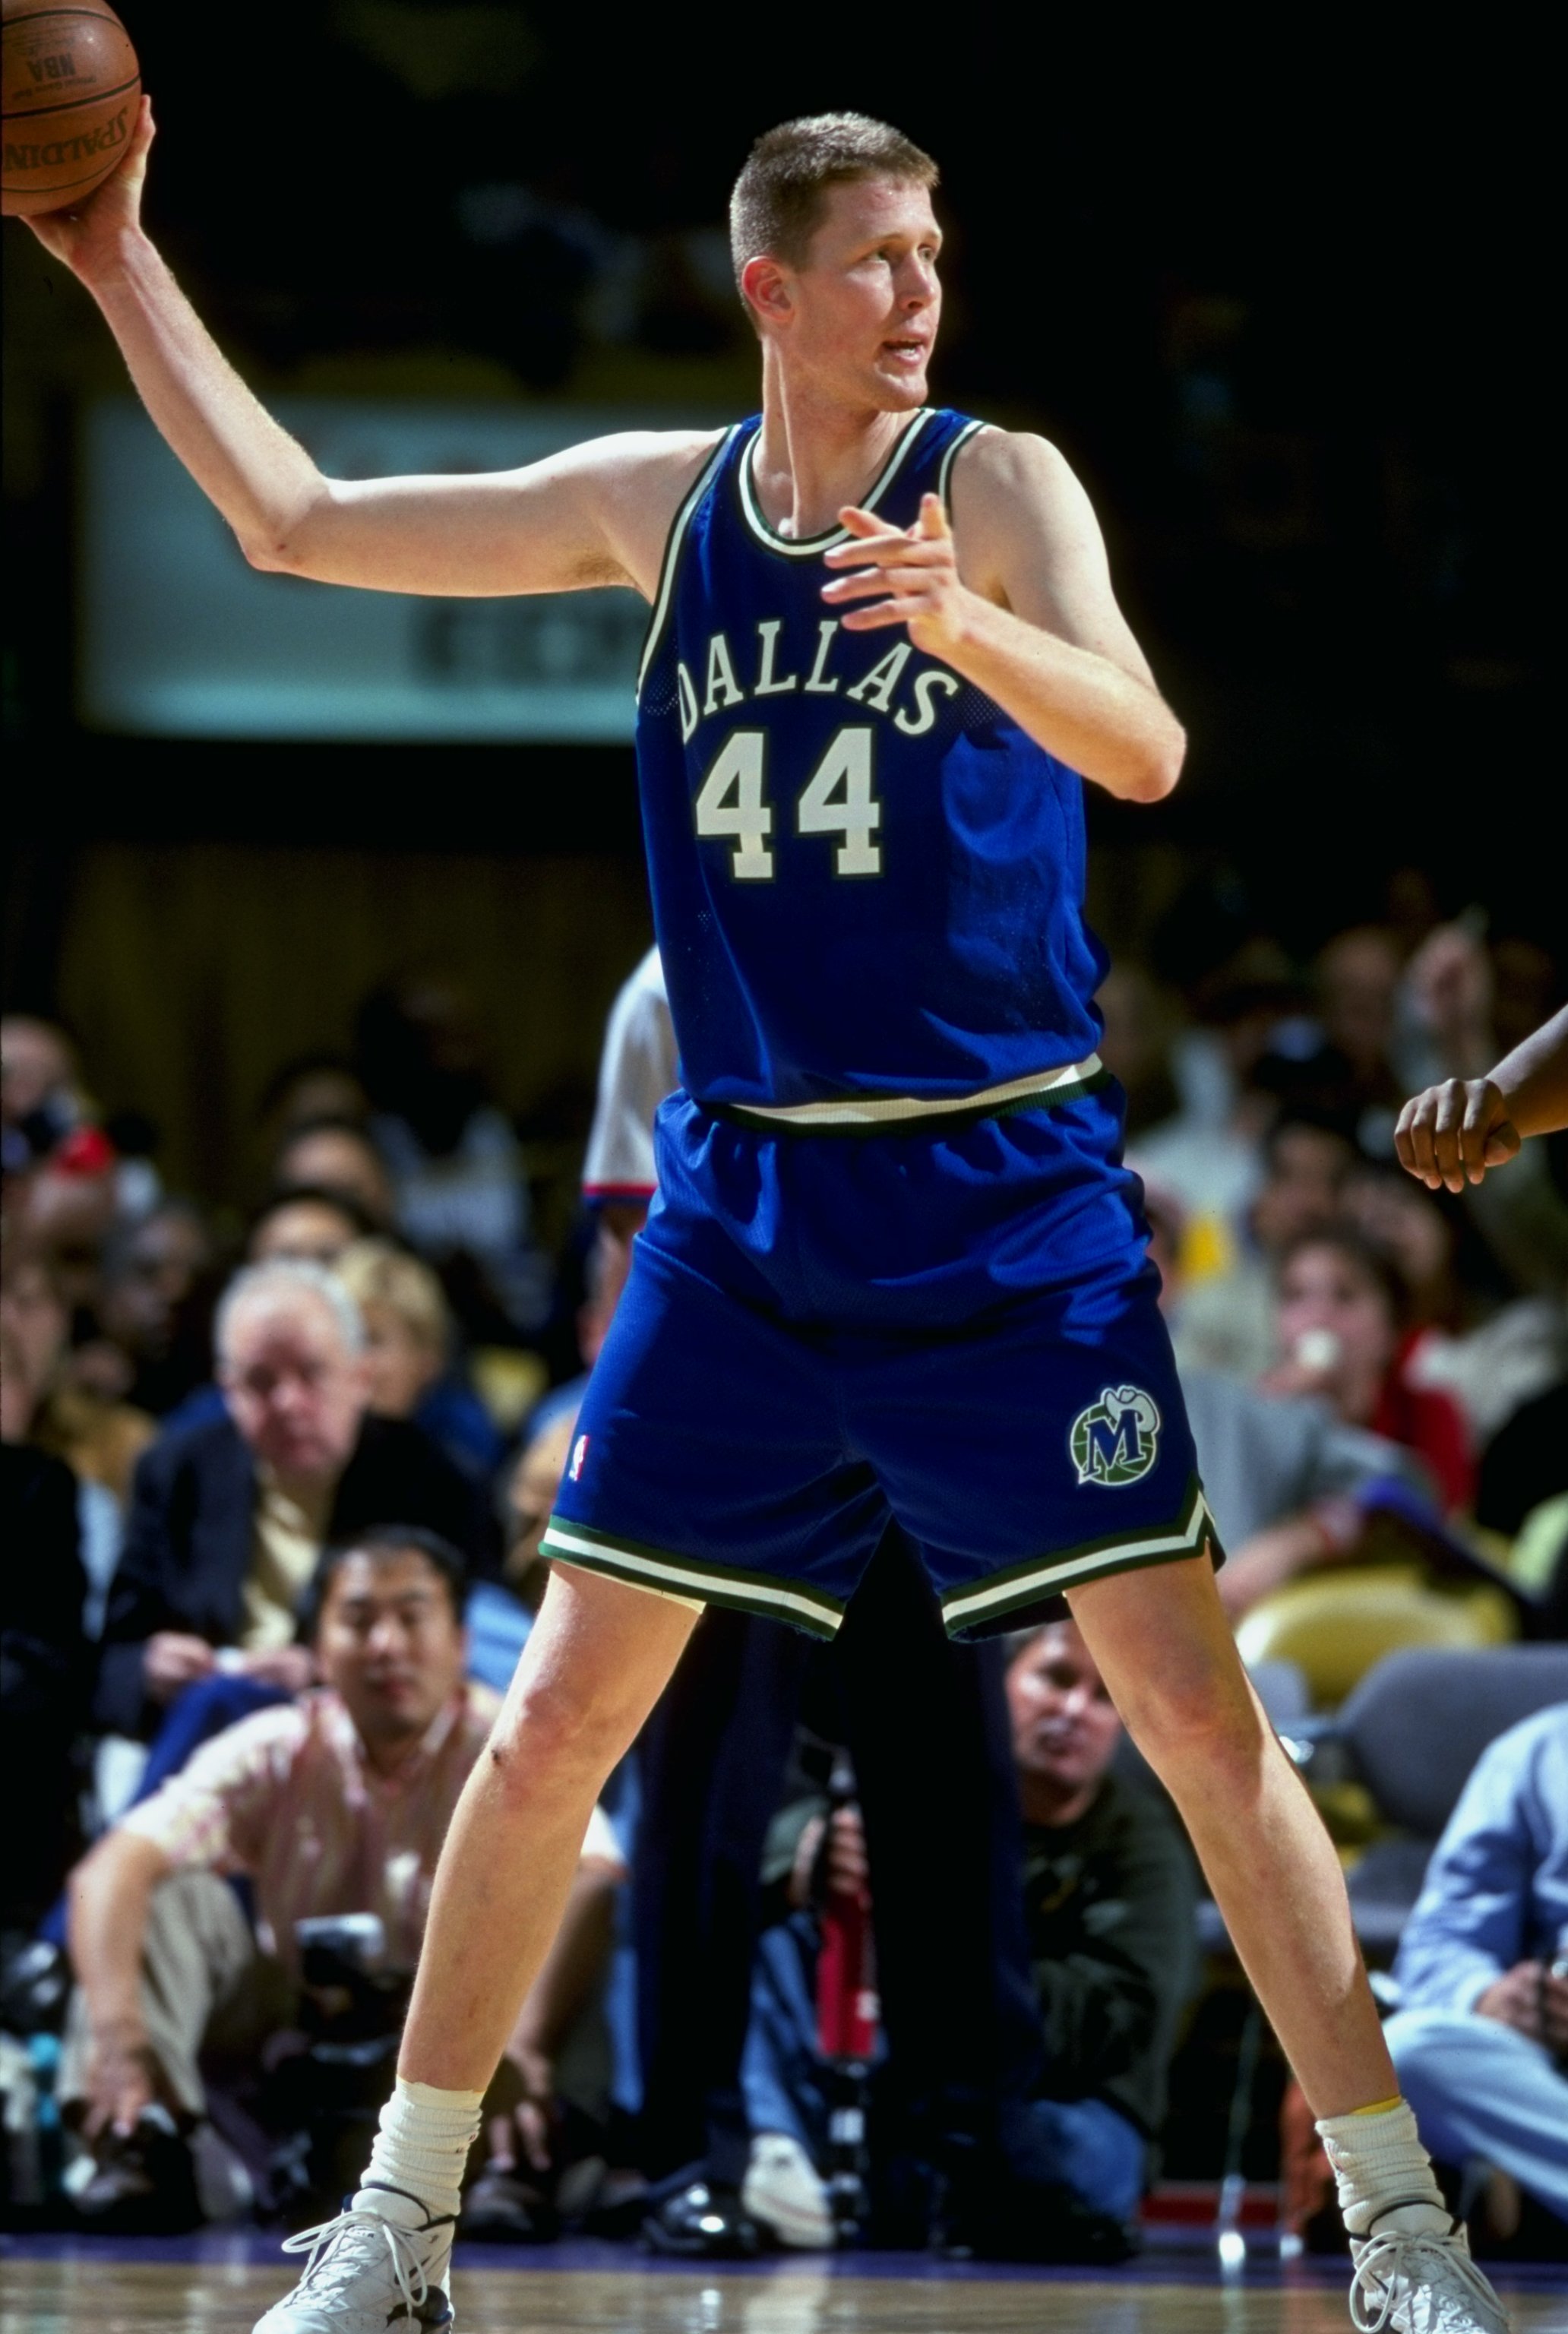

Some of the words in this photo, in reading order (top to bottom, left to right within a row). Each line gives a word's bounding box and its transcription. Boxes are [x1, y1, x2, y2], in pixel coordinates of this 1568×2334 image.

[27, 52, 76, 83] NBA
[678, 619, 959, 746] DALLAS
[696, 727, 880, 879] 44
[1080, 1408, 1147, 1481] M
